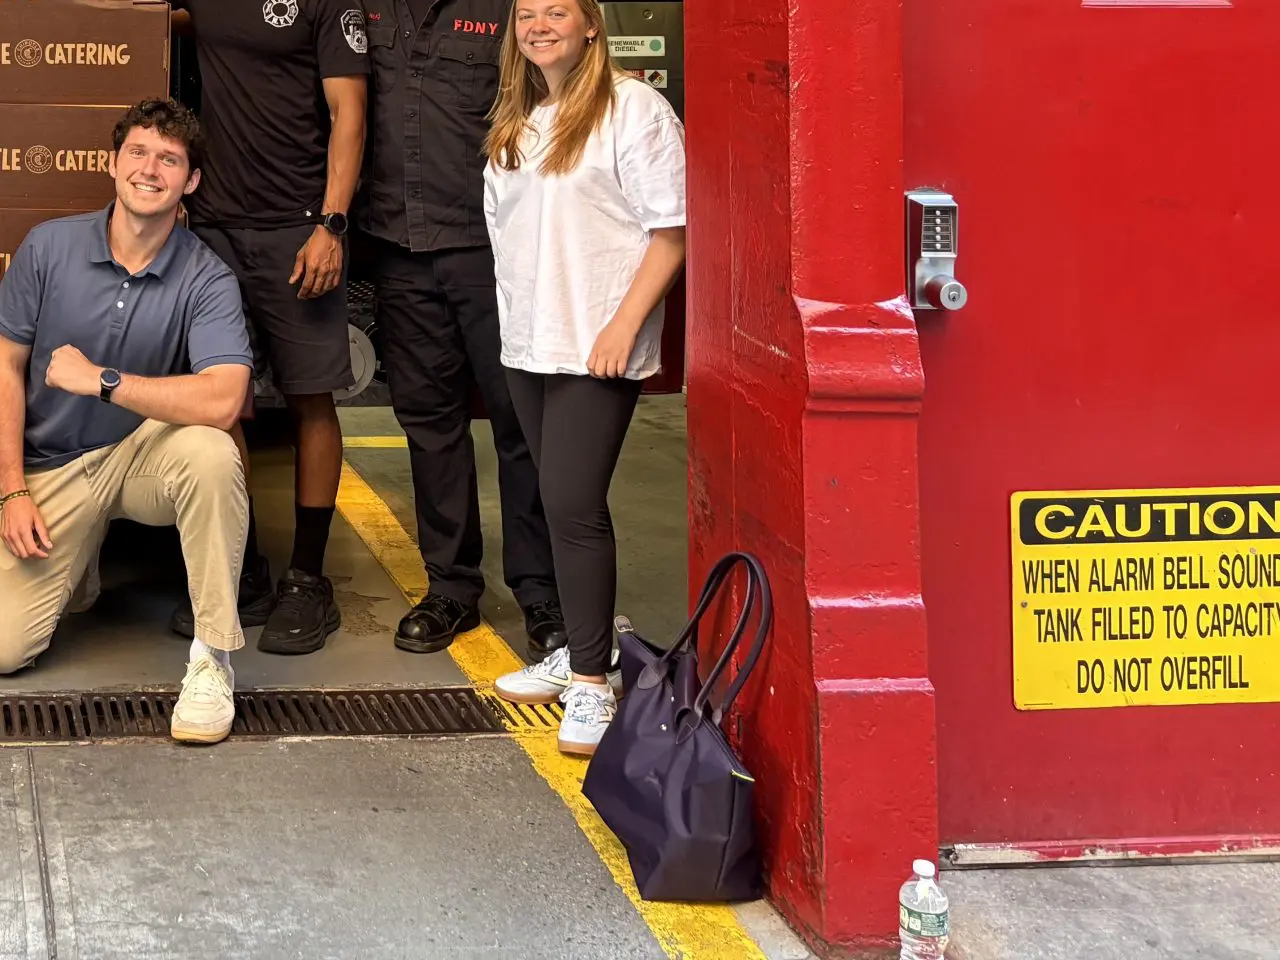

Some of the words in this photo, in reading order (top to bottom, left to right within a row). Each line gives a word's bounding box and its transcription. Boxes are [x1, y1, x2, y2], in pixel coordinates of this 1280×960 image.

[453, 19, 500, 35] FDNY
[44, 43, 131, 66] CATERING
[55, 149, 115, 172] CATERI
[1034, 501, 1280, 539] CAUTION
[1021, 559, 1080, 594] WHEN
[1088, 557, 1154, 593] ALARM
[1163, 555, 1210, 590] BELL
[1033, 607, 1084, 643] TANK
[1091, 605, 1154, 641] FILLED
[1162, 604, 1188, 639] TO
[1077, 658, 1105, 694] DO
[1113, 657, 1153, 693] NOT
[1160, 655, 1250, 691] OVERFILL
